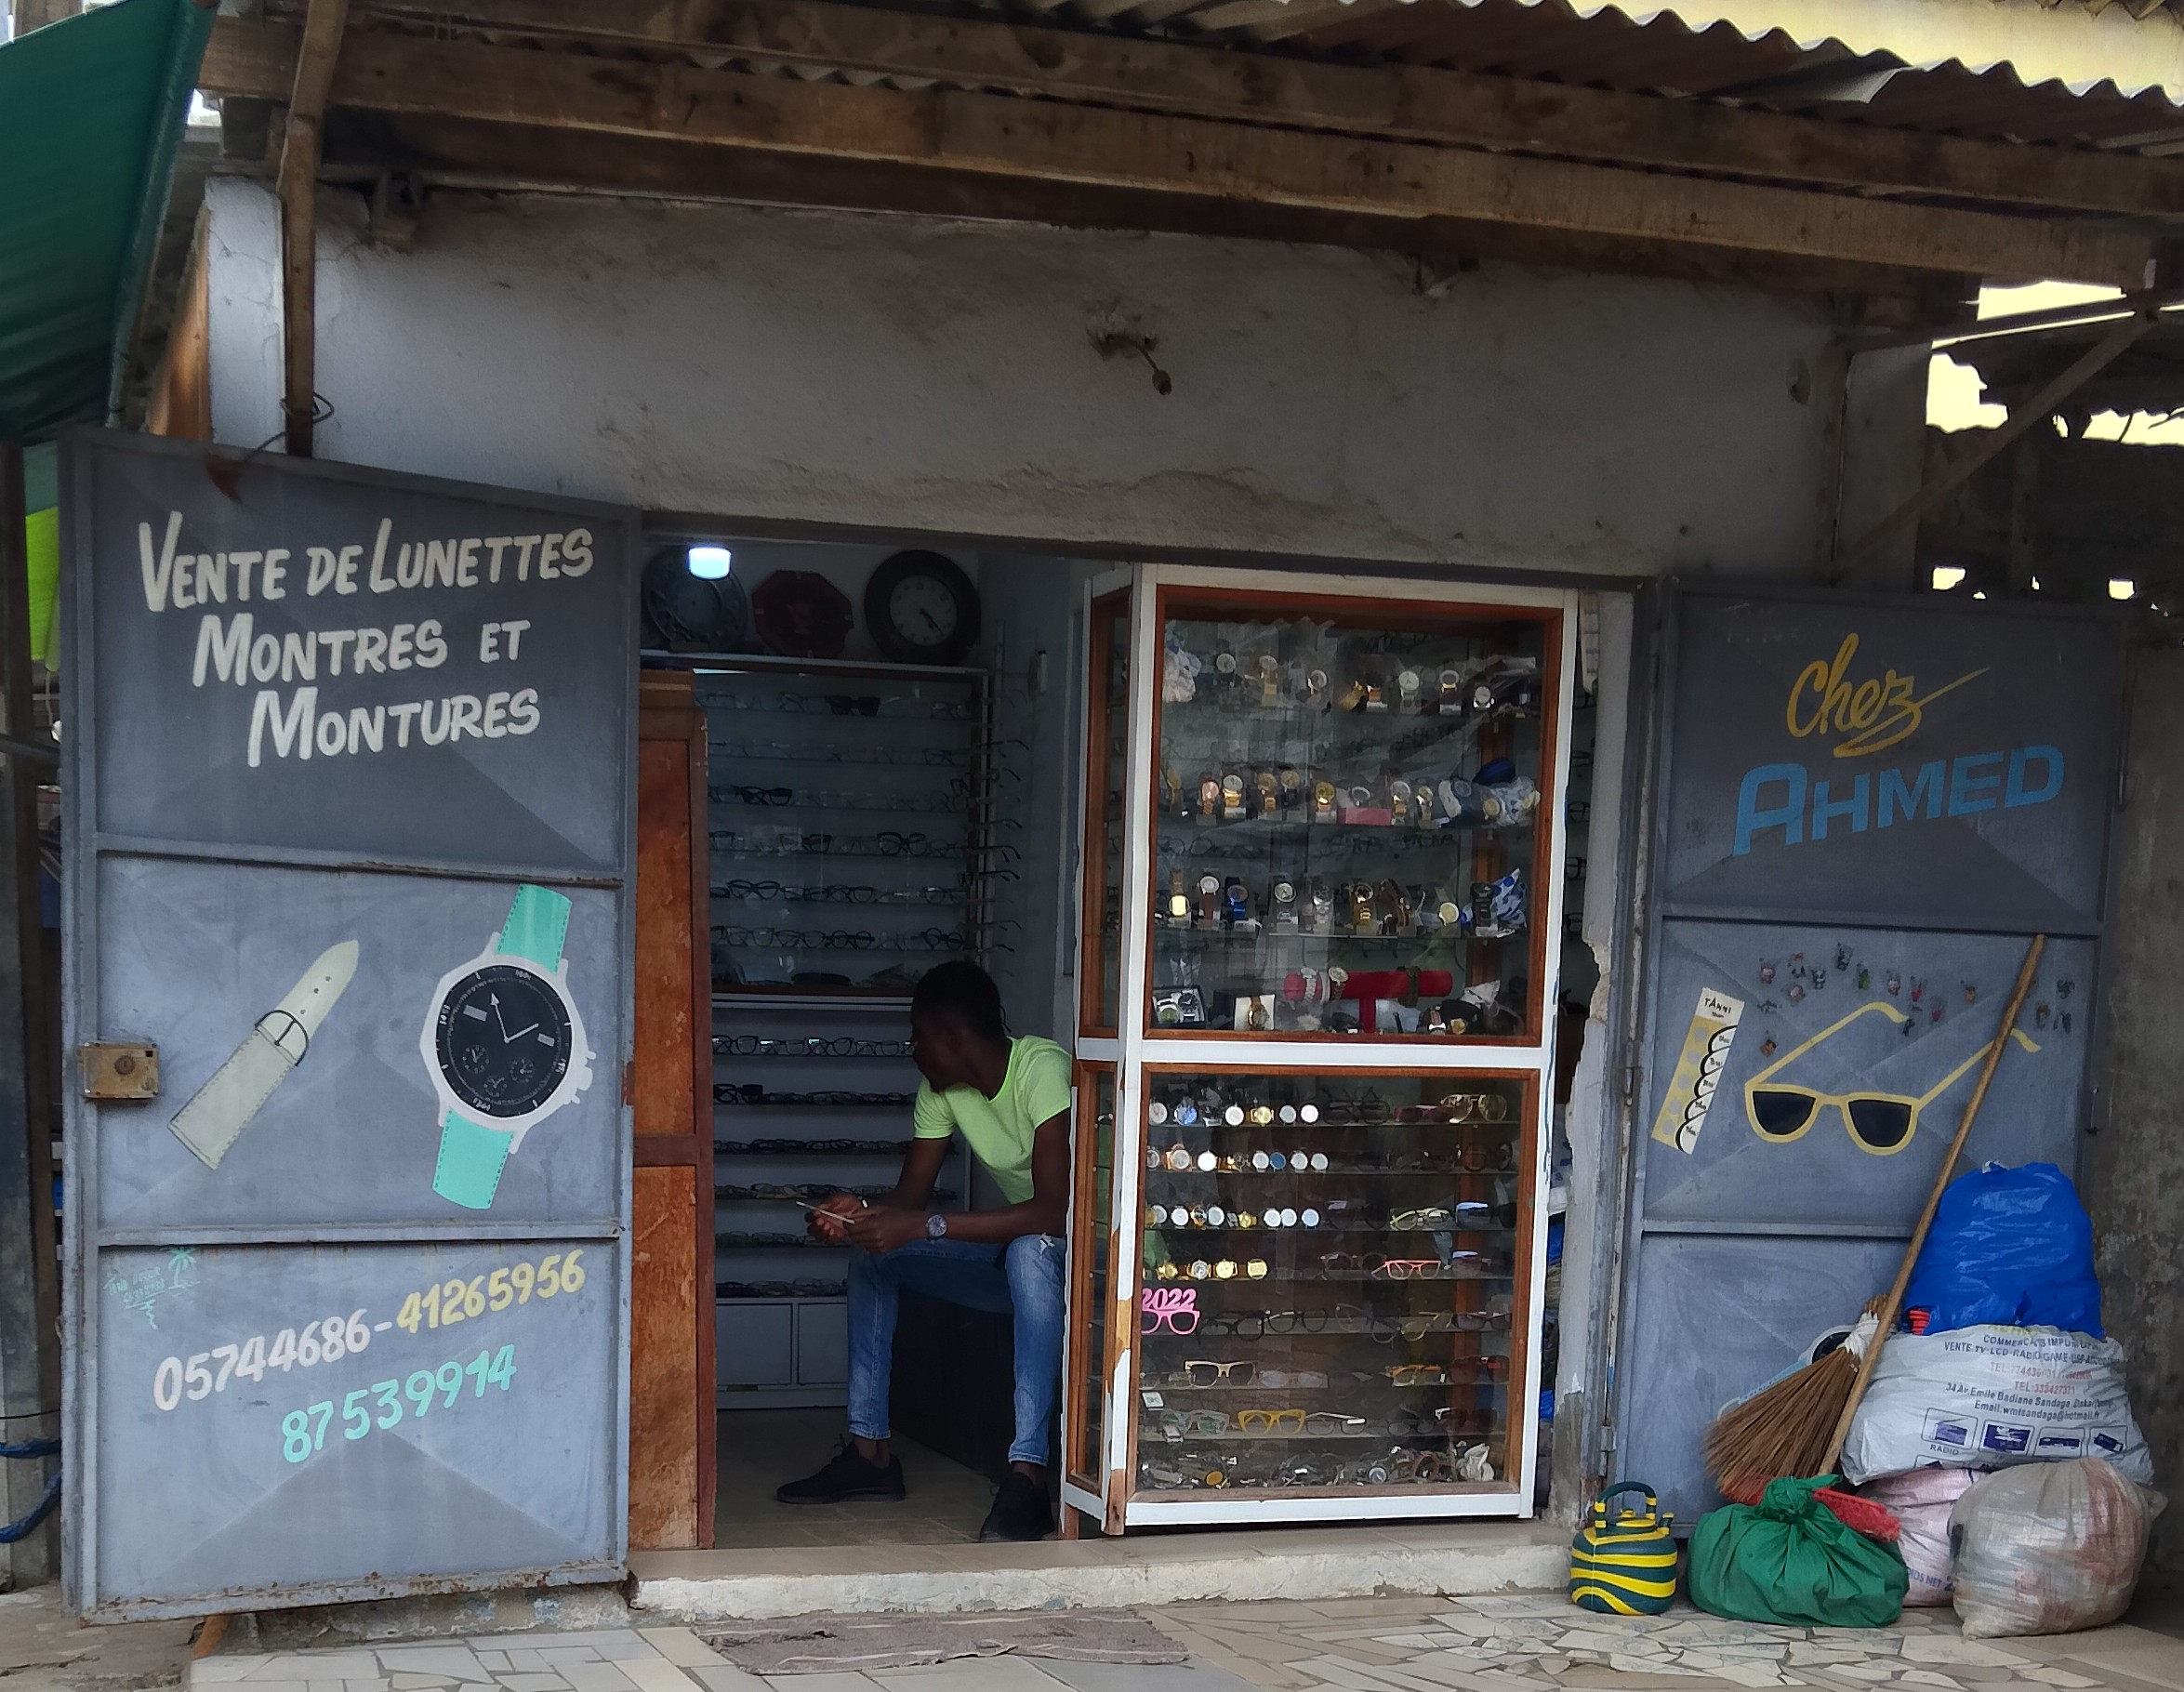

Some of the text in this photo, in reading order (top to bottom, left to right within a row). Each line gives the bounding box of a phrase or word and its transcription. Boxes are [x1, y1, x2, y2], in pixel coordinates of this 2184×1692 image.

[139, 510, 594, 612] VENTE DE LUNETTES
[192, 612, 531, 687] MONTRES ET
[247, 686, 541, 768] MONTURES
[1786, 632, 1991, 759] Chez
[1732, 744, 2065, 857] AHMED
[1142, 1288, 1197, 1311] 2022
[282, 1343, 517, 1463] 87539914
[1997, 1391, 2033, 1406] Badiane
[2035, 1397, 2071, 1409] Sandaga
[1930, 1444, 1959, 1455] RADIO
[1926, 1575, 1942, 1588] NET
